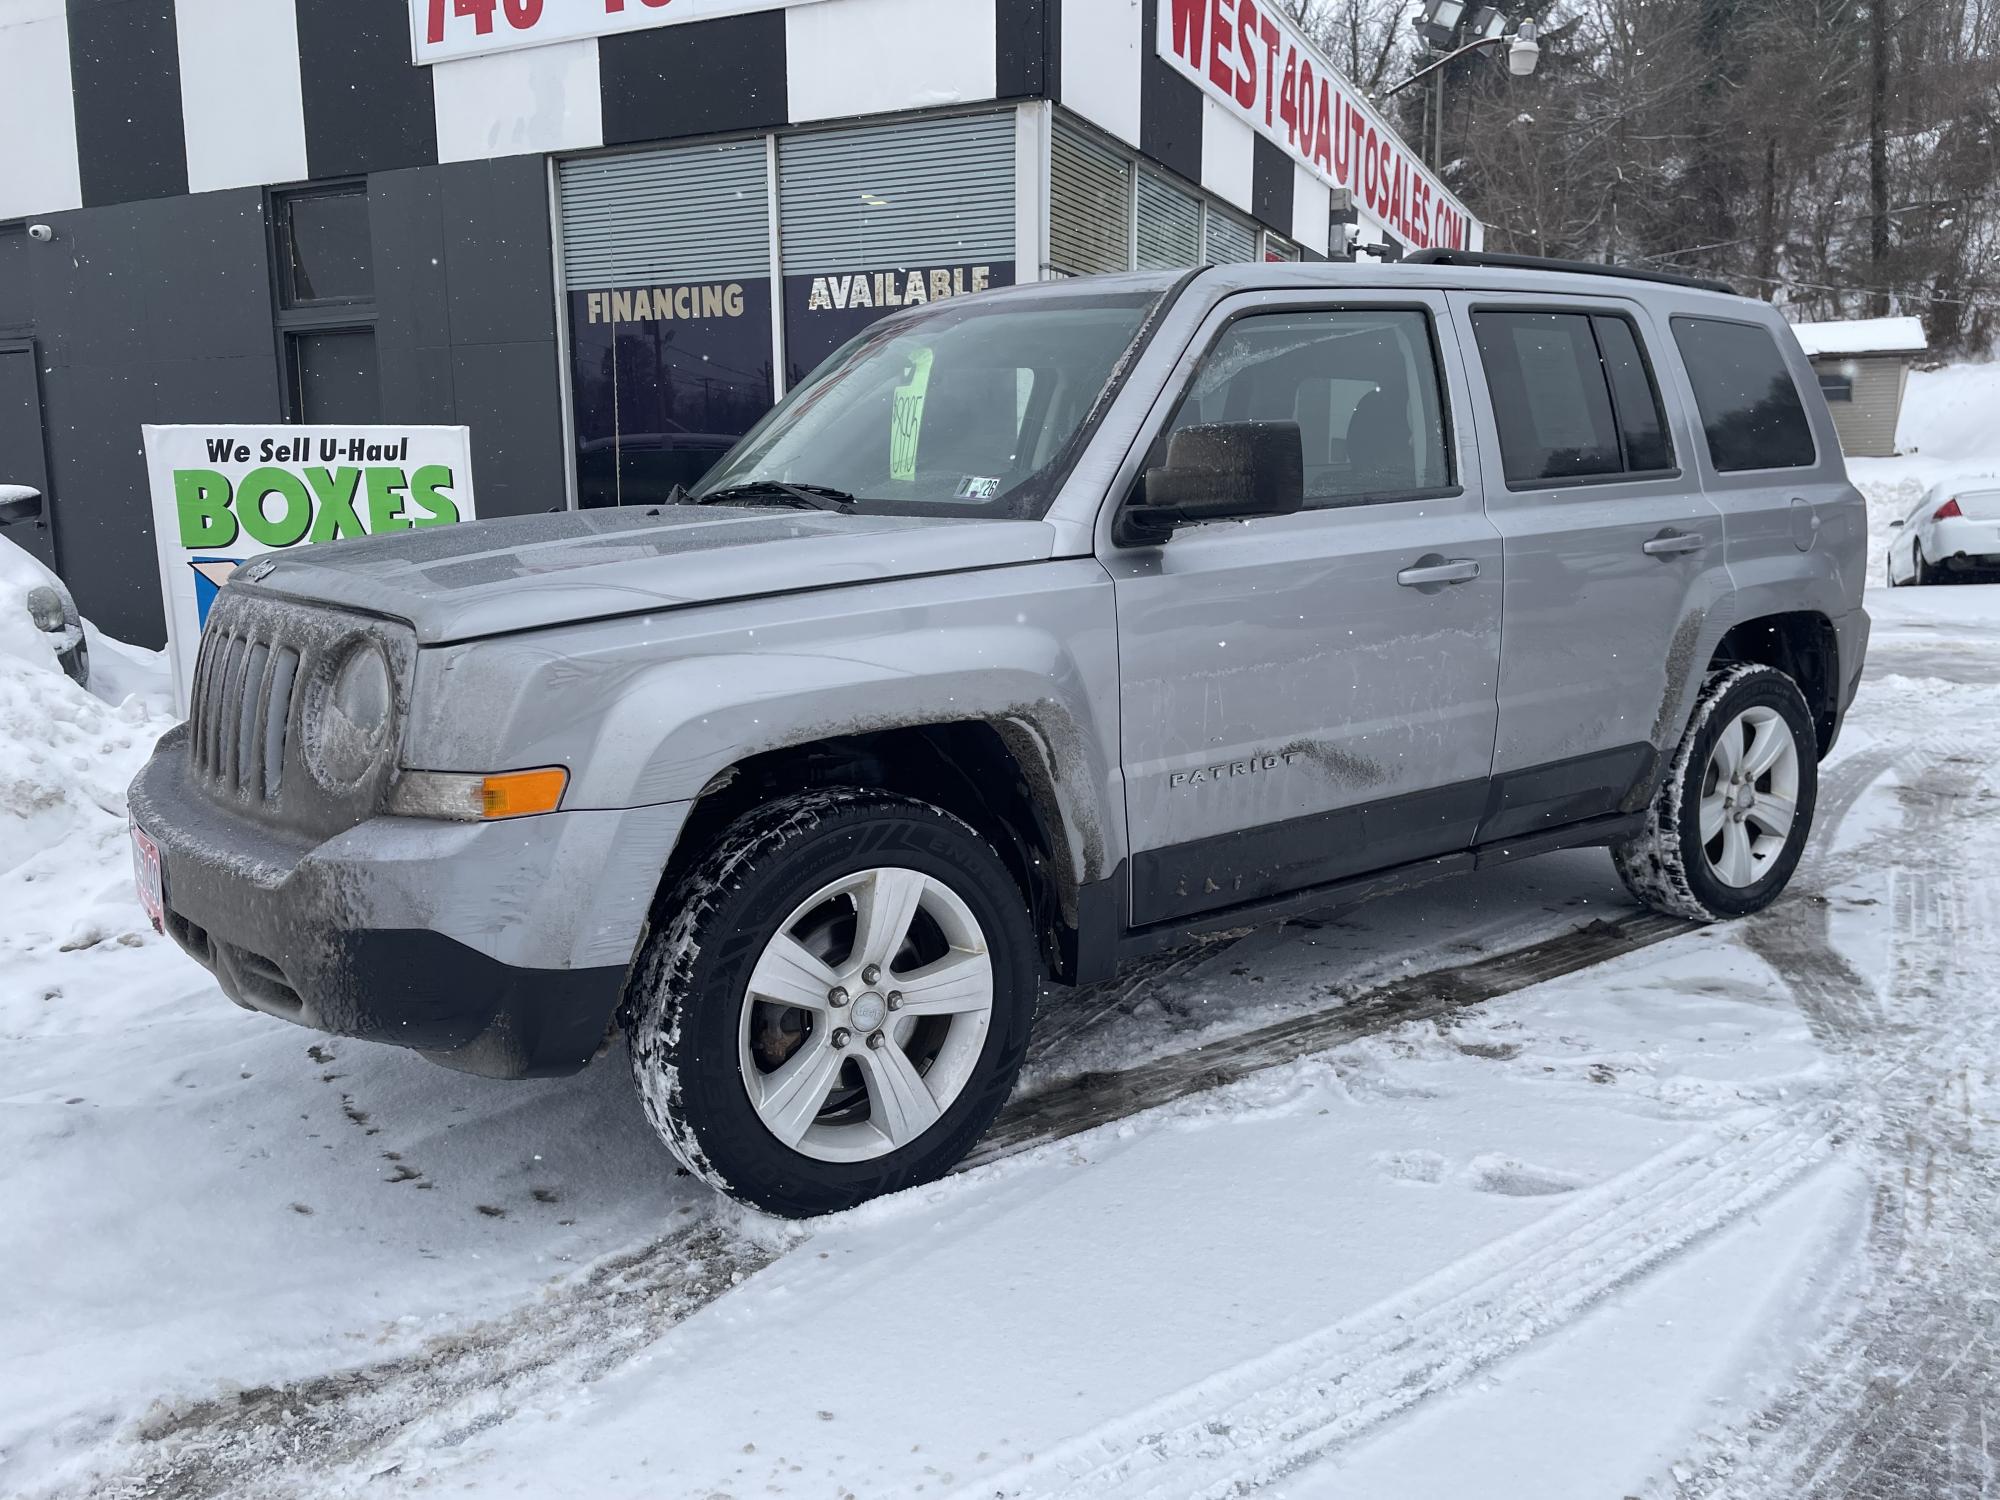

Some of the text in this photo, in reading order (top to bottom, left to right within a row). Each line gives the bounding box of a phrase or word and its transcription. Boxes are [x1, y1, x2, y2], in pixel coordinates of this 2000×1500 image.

[587, 266, 990, 323] FINANCING AVAILABLE
[206, 437, 408, 463] We Sell U-Haul
[982, 479, 997, 496] 26
[173, 465, 460, 549] BOXES
[1170, 751, 1300, 788] PATRIOT
